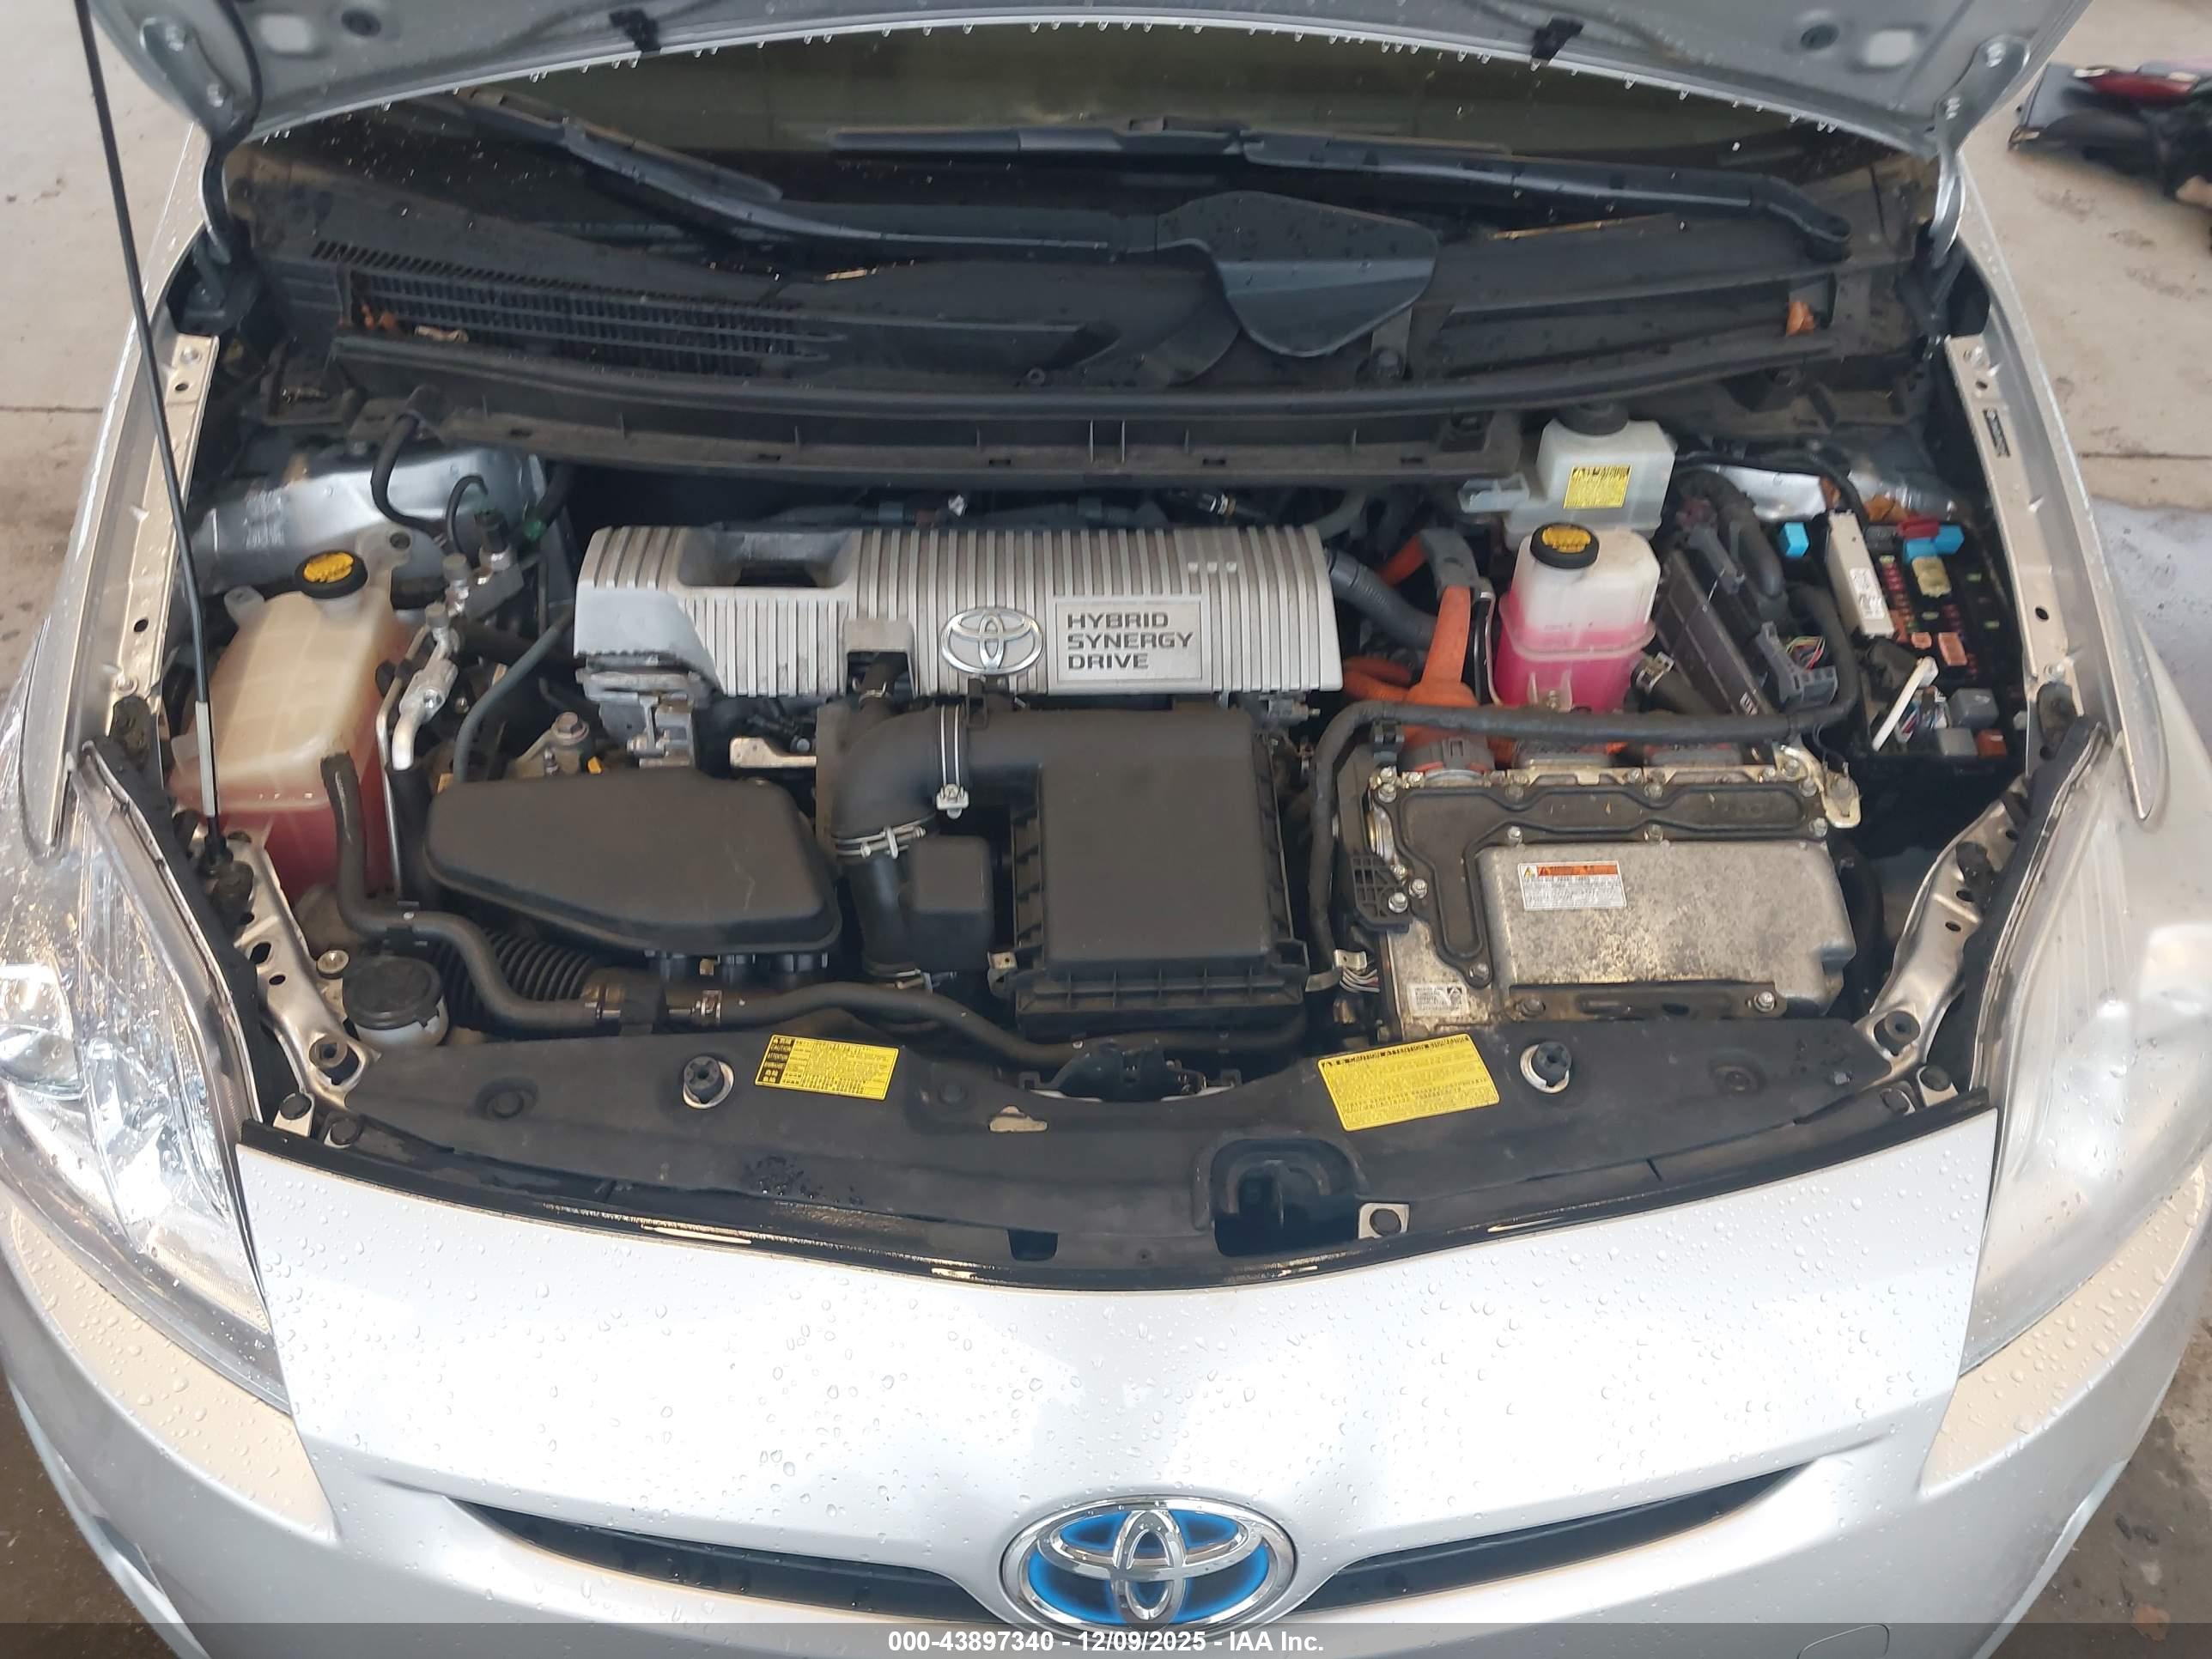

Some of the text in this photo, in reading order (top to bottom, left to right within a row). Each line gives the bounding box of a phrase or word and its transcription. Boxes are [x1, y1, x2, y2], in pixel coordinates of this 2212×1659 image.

[1067, 612, 1169, 629] HYBRID
[1067, 632, 1194, 650] SYNERGY
[1068, 653, 1149, 670] DRIVE
